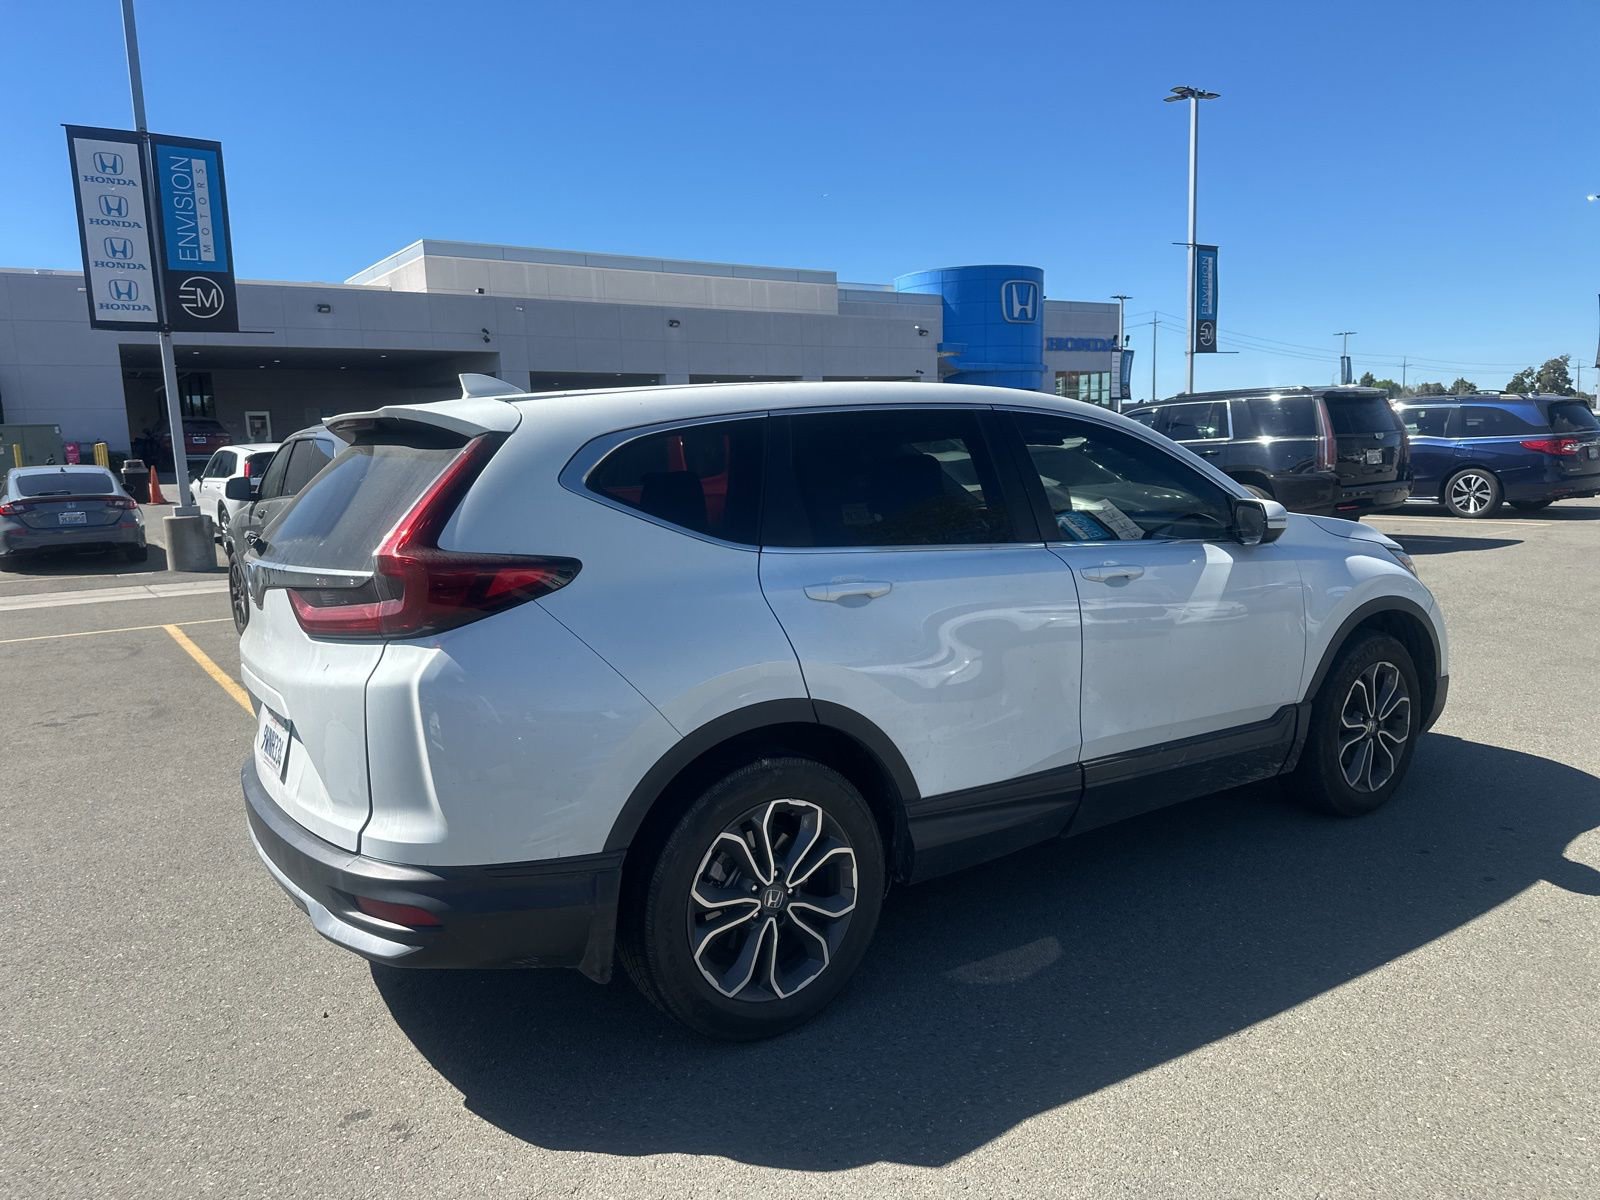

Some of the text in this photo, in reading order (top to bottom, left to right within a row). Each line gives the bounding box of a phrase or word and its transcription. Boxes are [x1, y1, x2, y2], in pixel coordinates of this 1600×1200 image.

[83, 175, 138, 187] HONDA
[170, 156, 199, 261] ENVISION
[195, 168, 211, 254] MOTORS
[89, 217, 143, 229] HONDA
[94, 260, 147, 271] HONDA
[99, 302, 153, 312] HONDA
